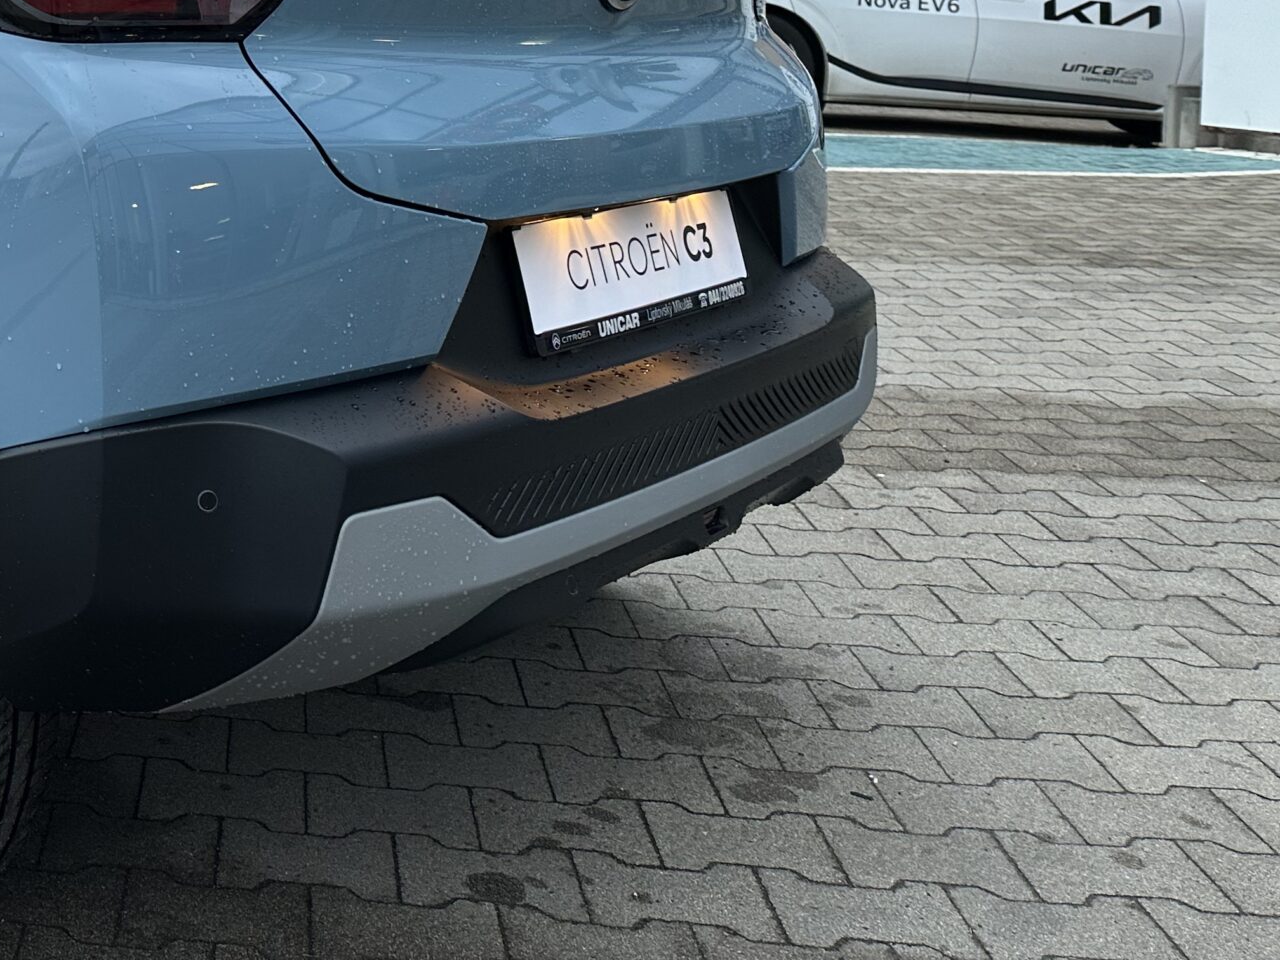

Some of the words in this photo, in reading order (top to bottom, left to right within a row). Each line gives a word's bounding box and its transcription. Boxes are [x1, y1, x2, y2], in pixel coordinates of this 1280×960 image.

[566, 222, 681, 291] CITROËN
[682, 222, 713, 262] C3
[597, 312, 640, 338] UNICAR
